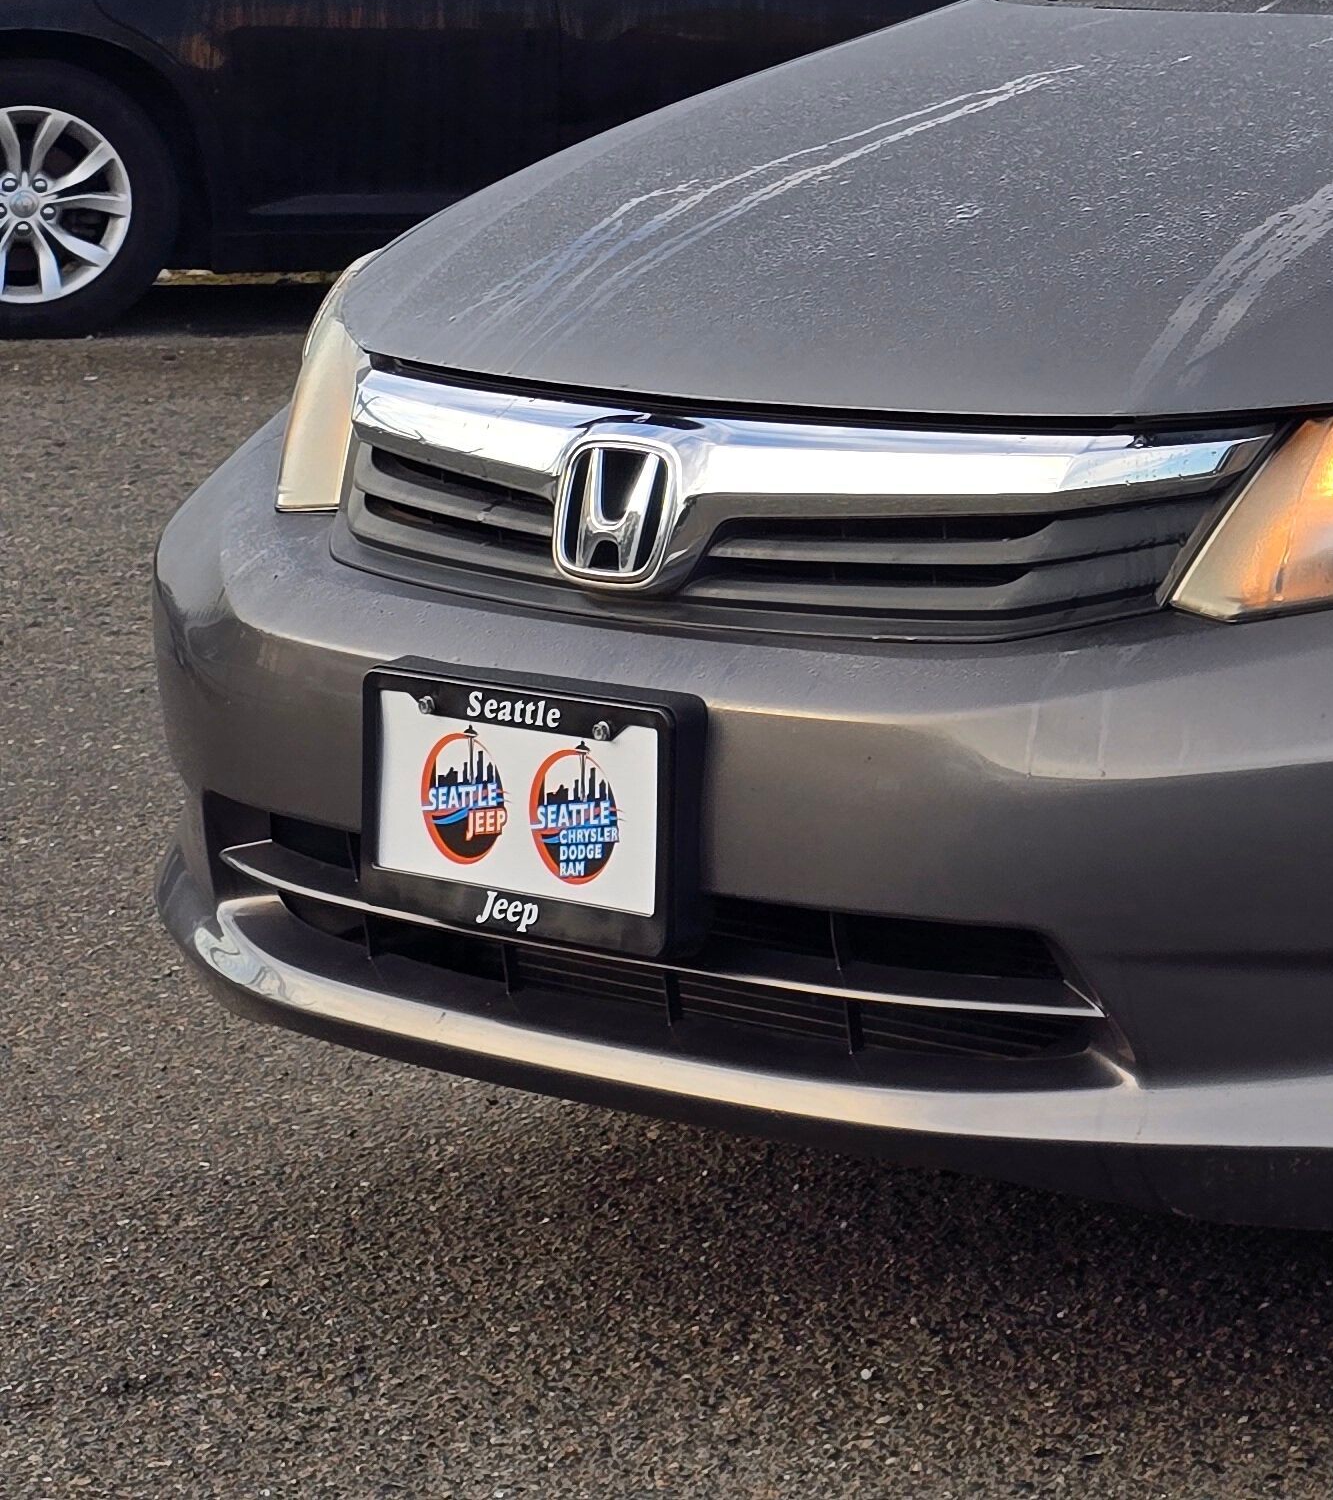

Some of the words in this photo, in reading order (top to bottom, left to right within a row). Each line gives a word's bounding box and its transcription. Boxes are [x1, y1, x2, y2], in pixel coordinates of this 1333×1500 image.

[466, 691, 561, 728] Seattle
[428, 783, 498, 811] SEATTLE
[465, 808, 507, 841] JEEP
[537, 801, 611, 828] SEATTLE
[559, 826, 619, 843] CHRYSLER
[559, 843, 602, 861] DODGE
[559, 862, 585, 877] RAM
[476, 891, 539, 933] Jeep
